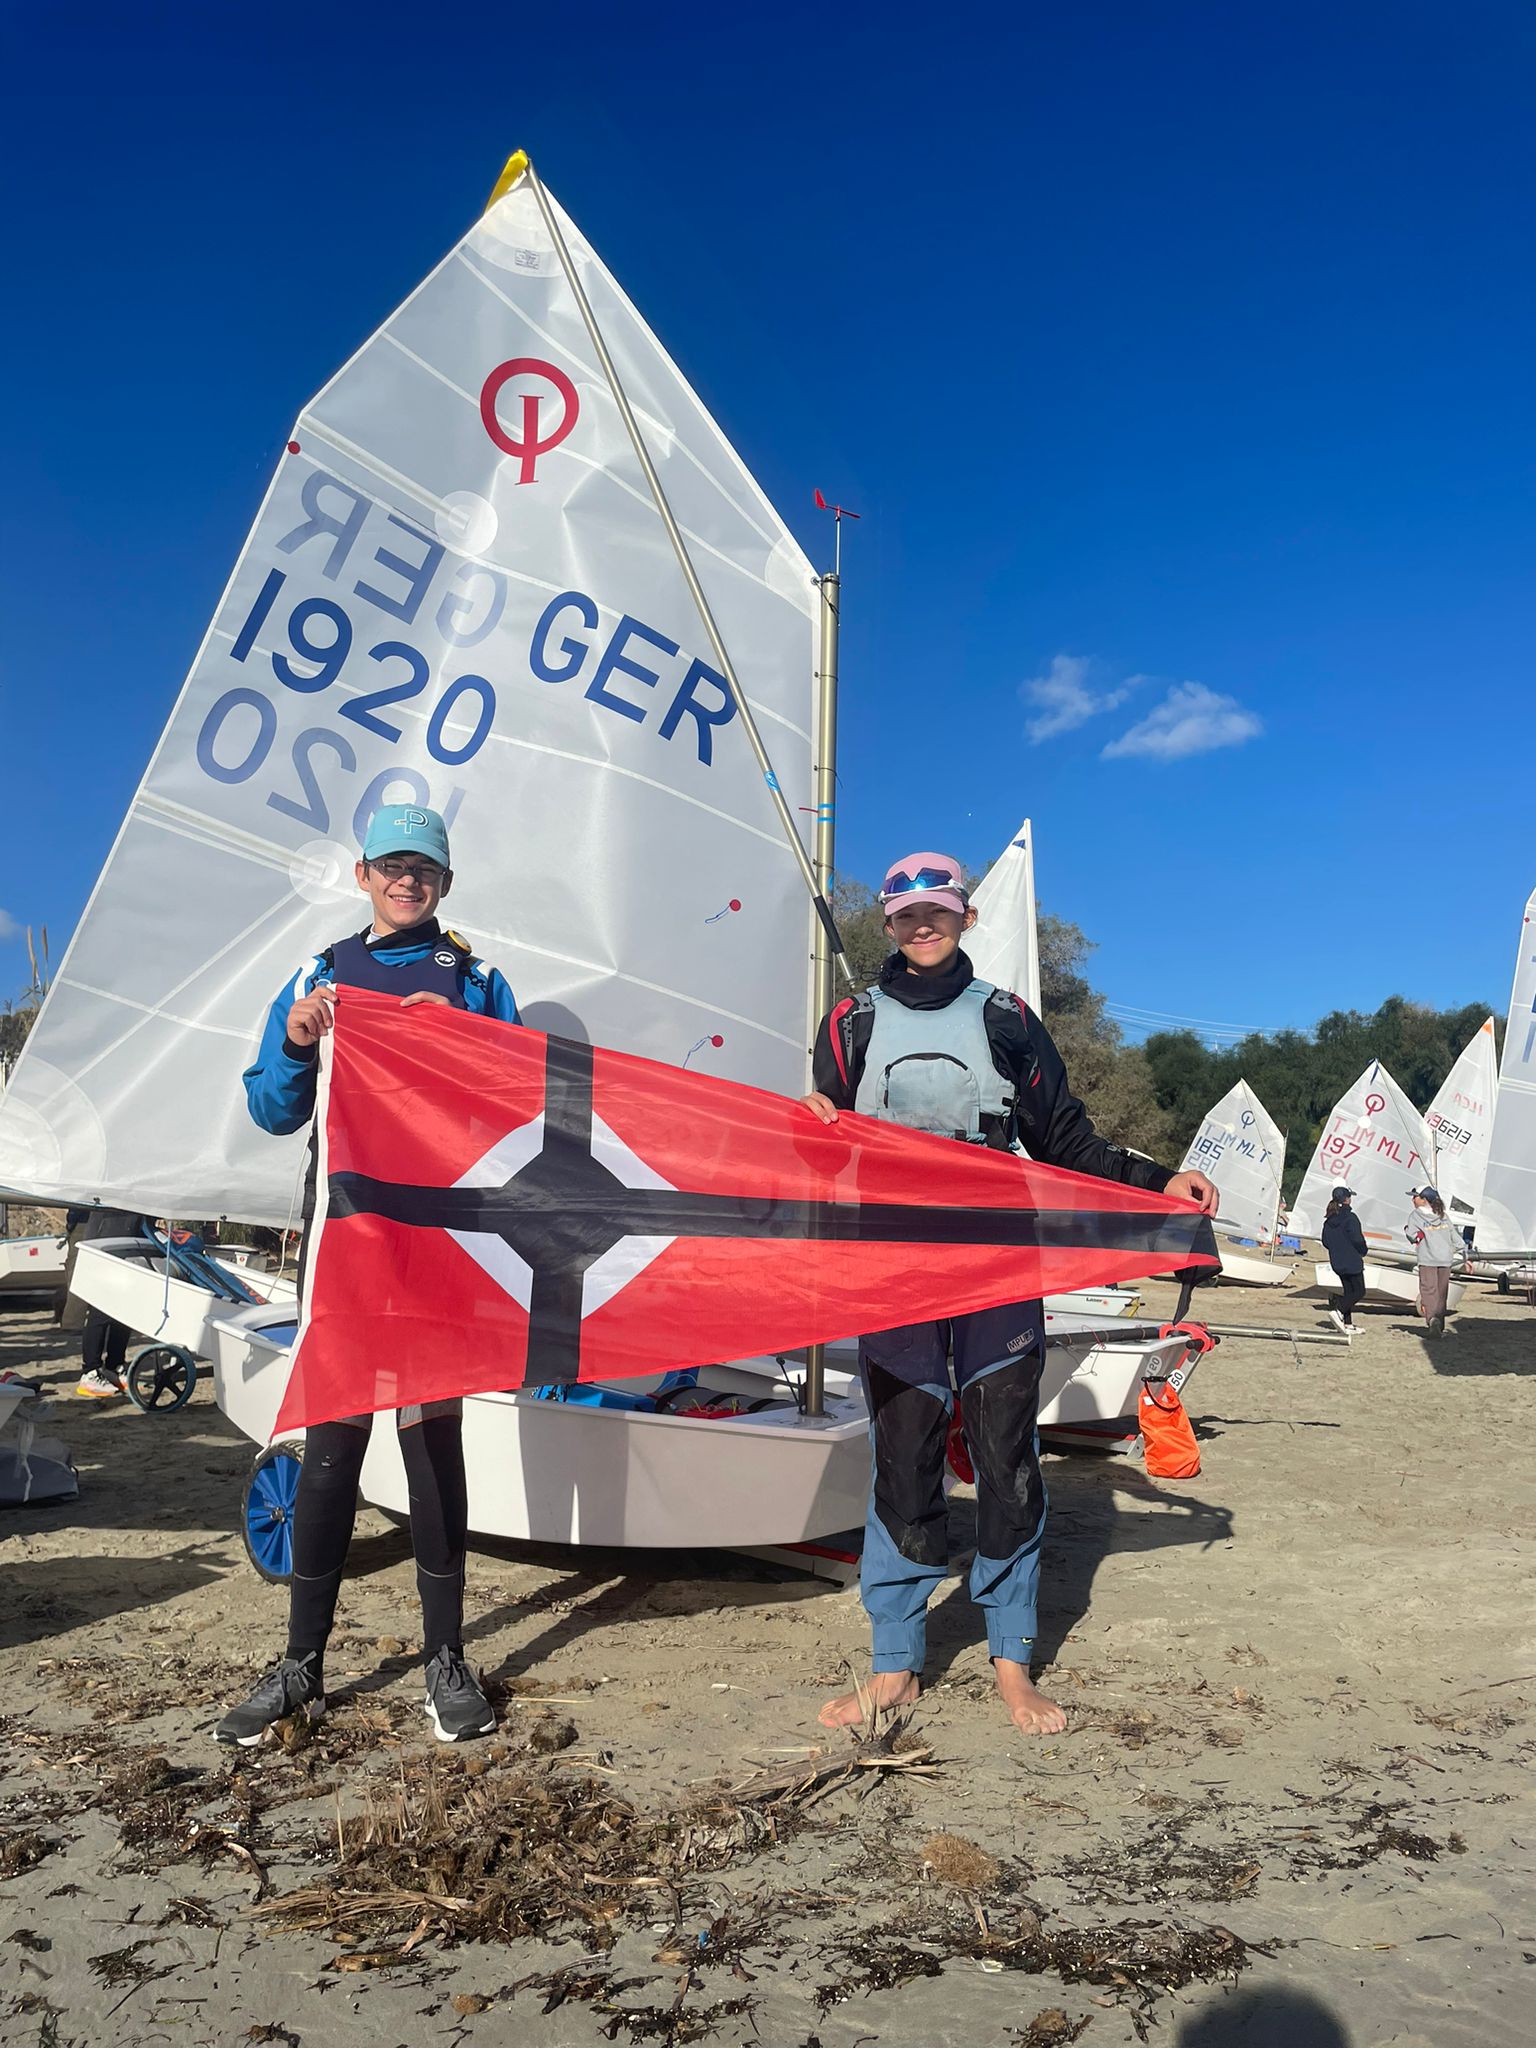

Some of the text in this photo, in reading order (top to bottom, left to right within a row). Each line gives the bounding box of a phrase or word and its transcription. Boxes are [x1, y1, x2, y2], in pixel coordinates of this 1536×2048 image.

[230, 568, 497, 766] 1920
[529, 591, 739, 767] GER
[1194, 1136, 1225, 1160] 185
[1235, 1139, 1272, 1163] MLT
[1323, 1134, 1360, 1159] 197
[1376, 1136, 1420, 1169] MLT
